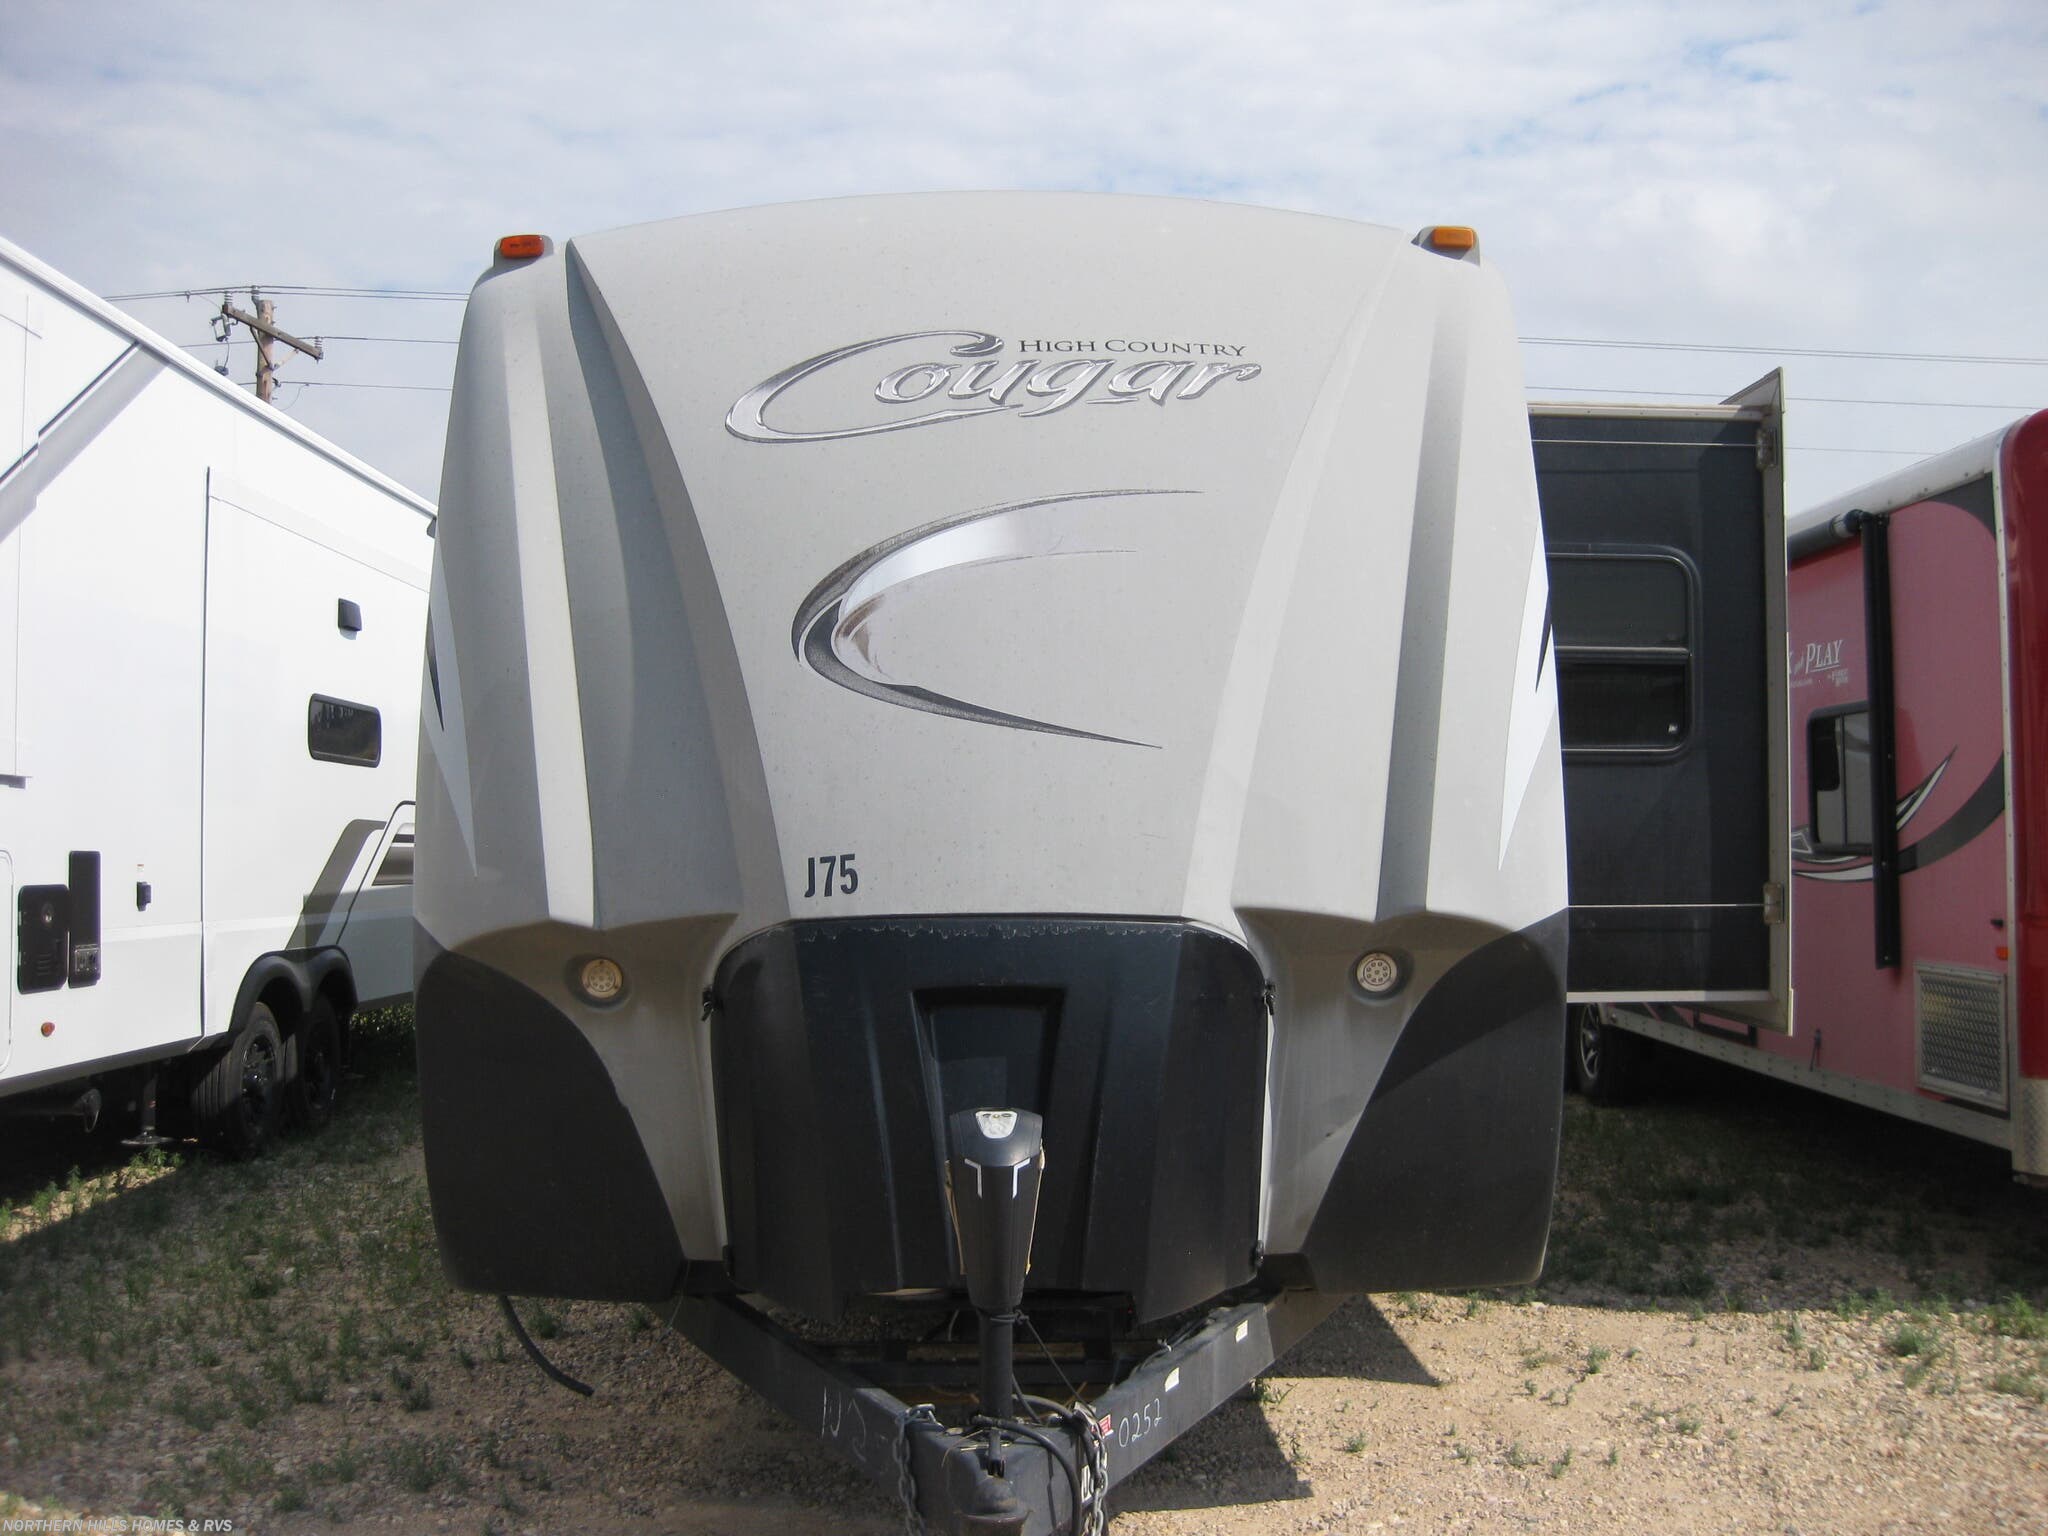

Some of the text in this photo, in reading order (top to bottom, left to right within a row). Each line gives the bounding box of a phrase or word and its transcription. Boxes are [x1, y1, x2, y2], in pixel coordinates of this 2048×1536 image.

[1018, 339, 1247, 357] HIGH COUNTRY
[724, 330, 1262, 444] Cougar
[1805, 639, 1843, 674] PLAY
[803, 853, 859, 898] J75
[1118, 1398, 1162, 1447] 0252
